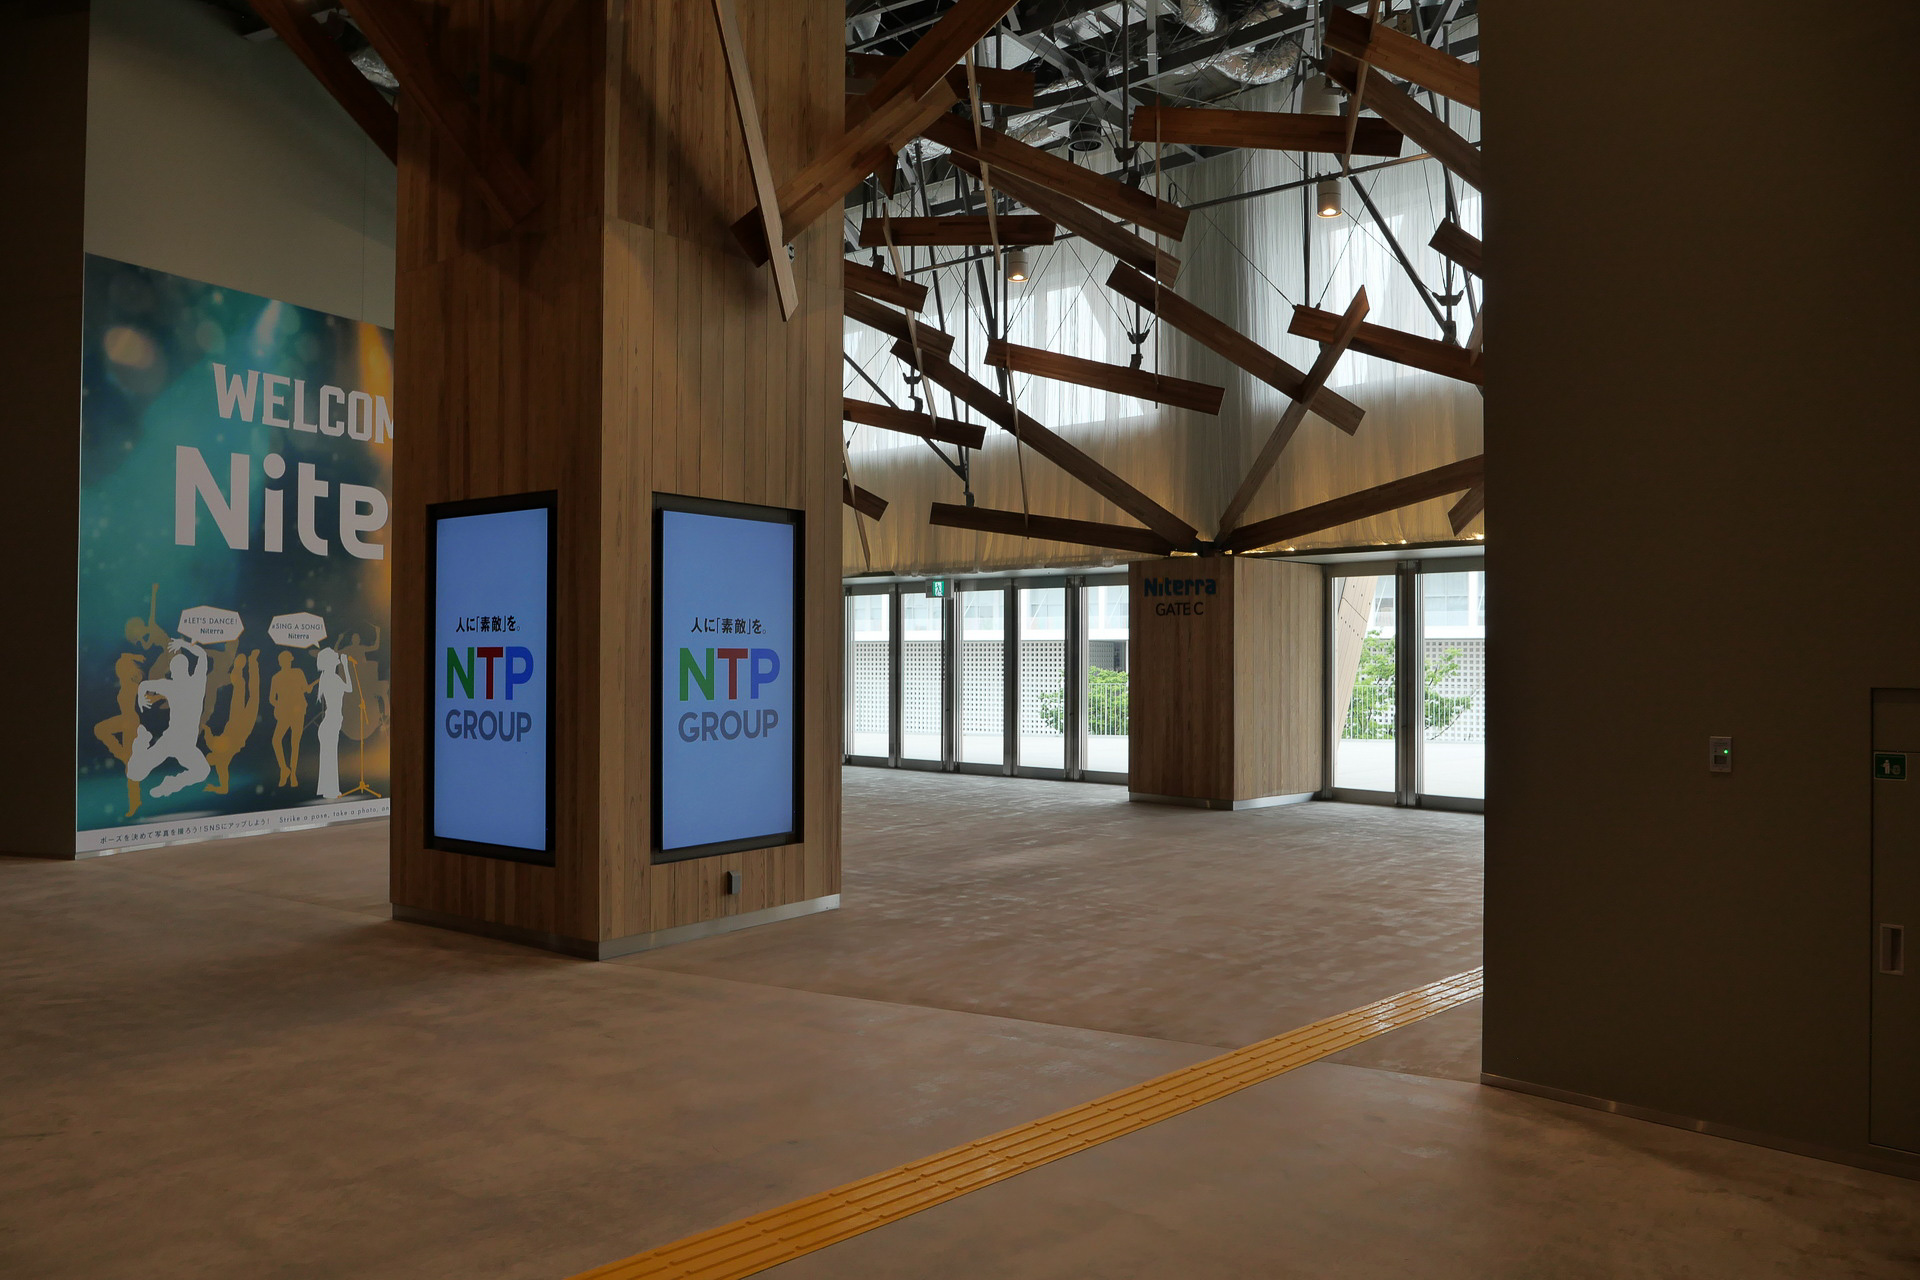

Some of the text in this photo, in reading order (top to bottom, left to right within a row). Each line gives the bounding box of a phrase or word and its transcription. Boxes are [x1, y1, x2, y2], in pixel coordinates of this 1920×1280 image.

[174, 445, 389, 560] Nite
[1144, 577, 1217, 597] Niterra
[1155, 602, 1204, 616] GATE C
[208, 617, 238, 626] DANCE!
[301, 623, 323, 631] SONG!
[455, 615, 521, 633] 人に「素敵」を。
[690, 616, 767, 635] 人に「素敵」を。
[200, 627, 224, 635] Niterra
[288, 632, 310, 640] Niterra
[446, 645, 534, 701] NTP
[678, 647, 781, 701] NTP
[445, 708, 532, 742] GROUP
[678, 708, 779, 743] GROUP
[279, 815, 301, 824] Strike
[311, 812, 330, 822] pose,
[357, 806, 379, 816] photo,
